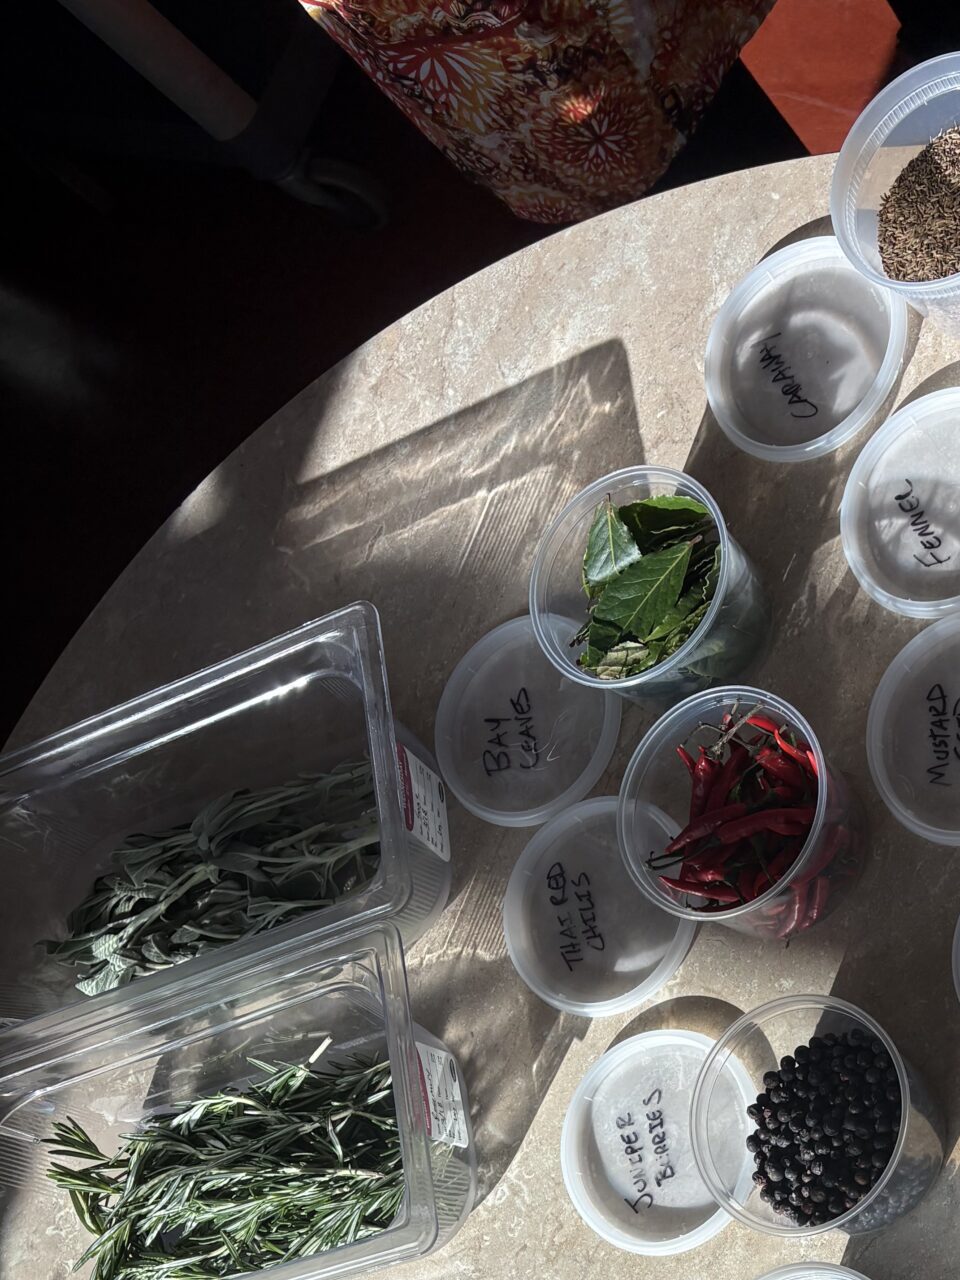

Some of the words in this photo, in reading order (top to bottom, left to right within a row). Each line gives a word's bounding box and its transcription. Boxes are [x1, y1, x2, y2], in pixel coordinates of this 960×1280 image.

[757, 331, 819, 419] CARAWAY
[893, 478, 951, 568] FENNEL
[482, 717, 512, 777] BAY
[510, 687, 540, 770] LEAVES
[926, 683, 952, 787] MUSTARD
[546, 862, 568, 907] RED
[571, 871, 606, 952] CHILIS
[560, 913, 584, 973] THAI
[616, 1112, 654, 1215] JUNIPER
